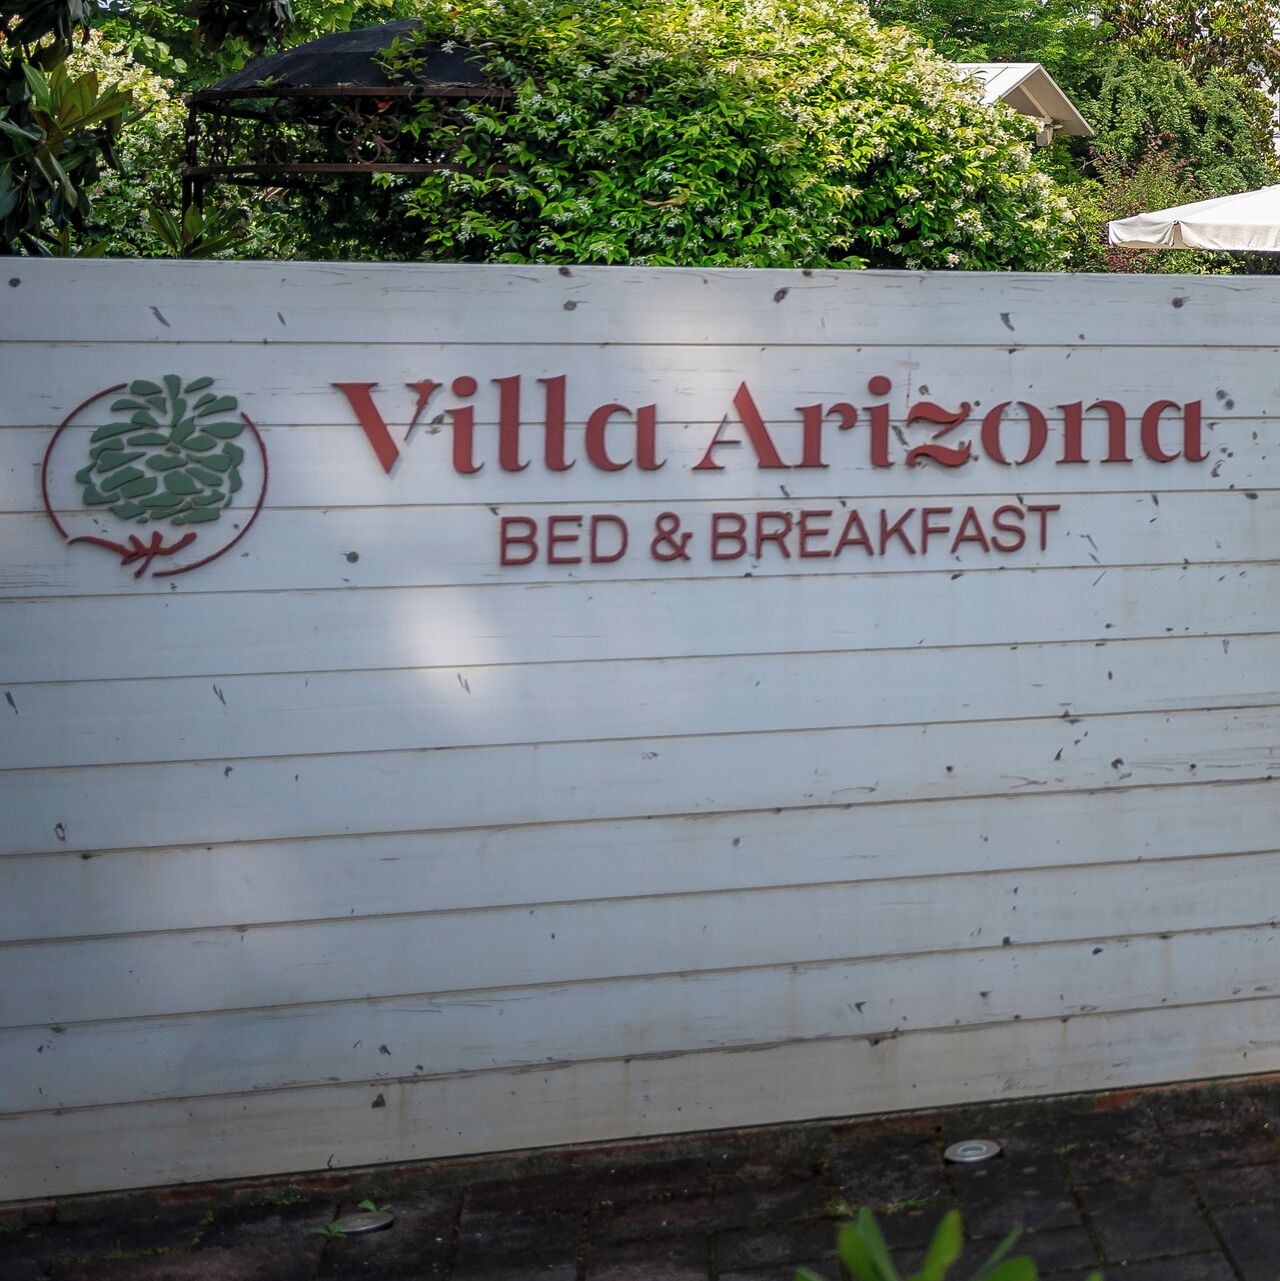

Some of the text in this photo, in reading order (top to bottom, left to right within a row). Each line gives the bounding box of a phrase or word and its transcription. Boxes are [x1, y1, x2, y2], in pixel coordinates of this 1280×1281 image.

[330, 374, 1211, 475] Villa Arizona
[501, 504, 1061, 566] BED & BREAKFAST
